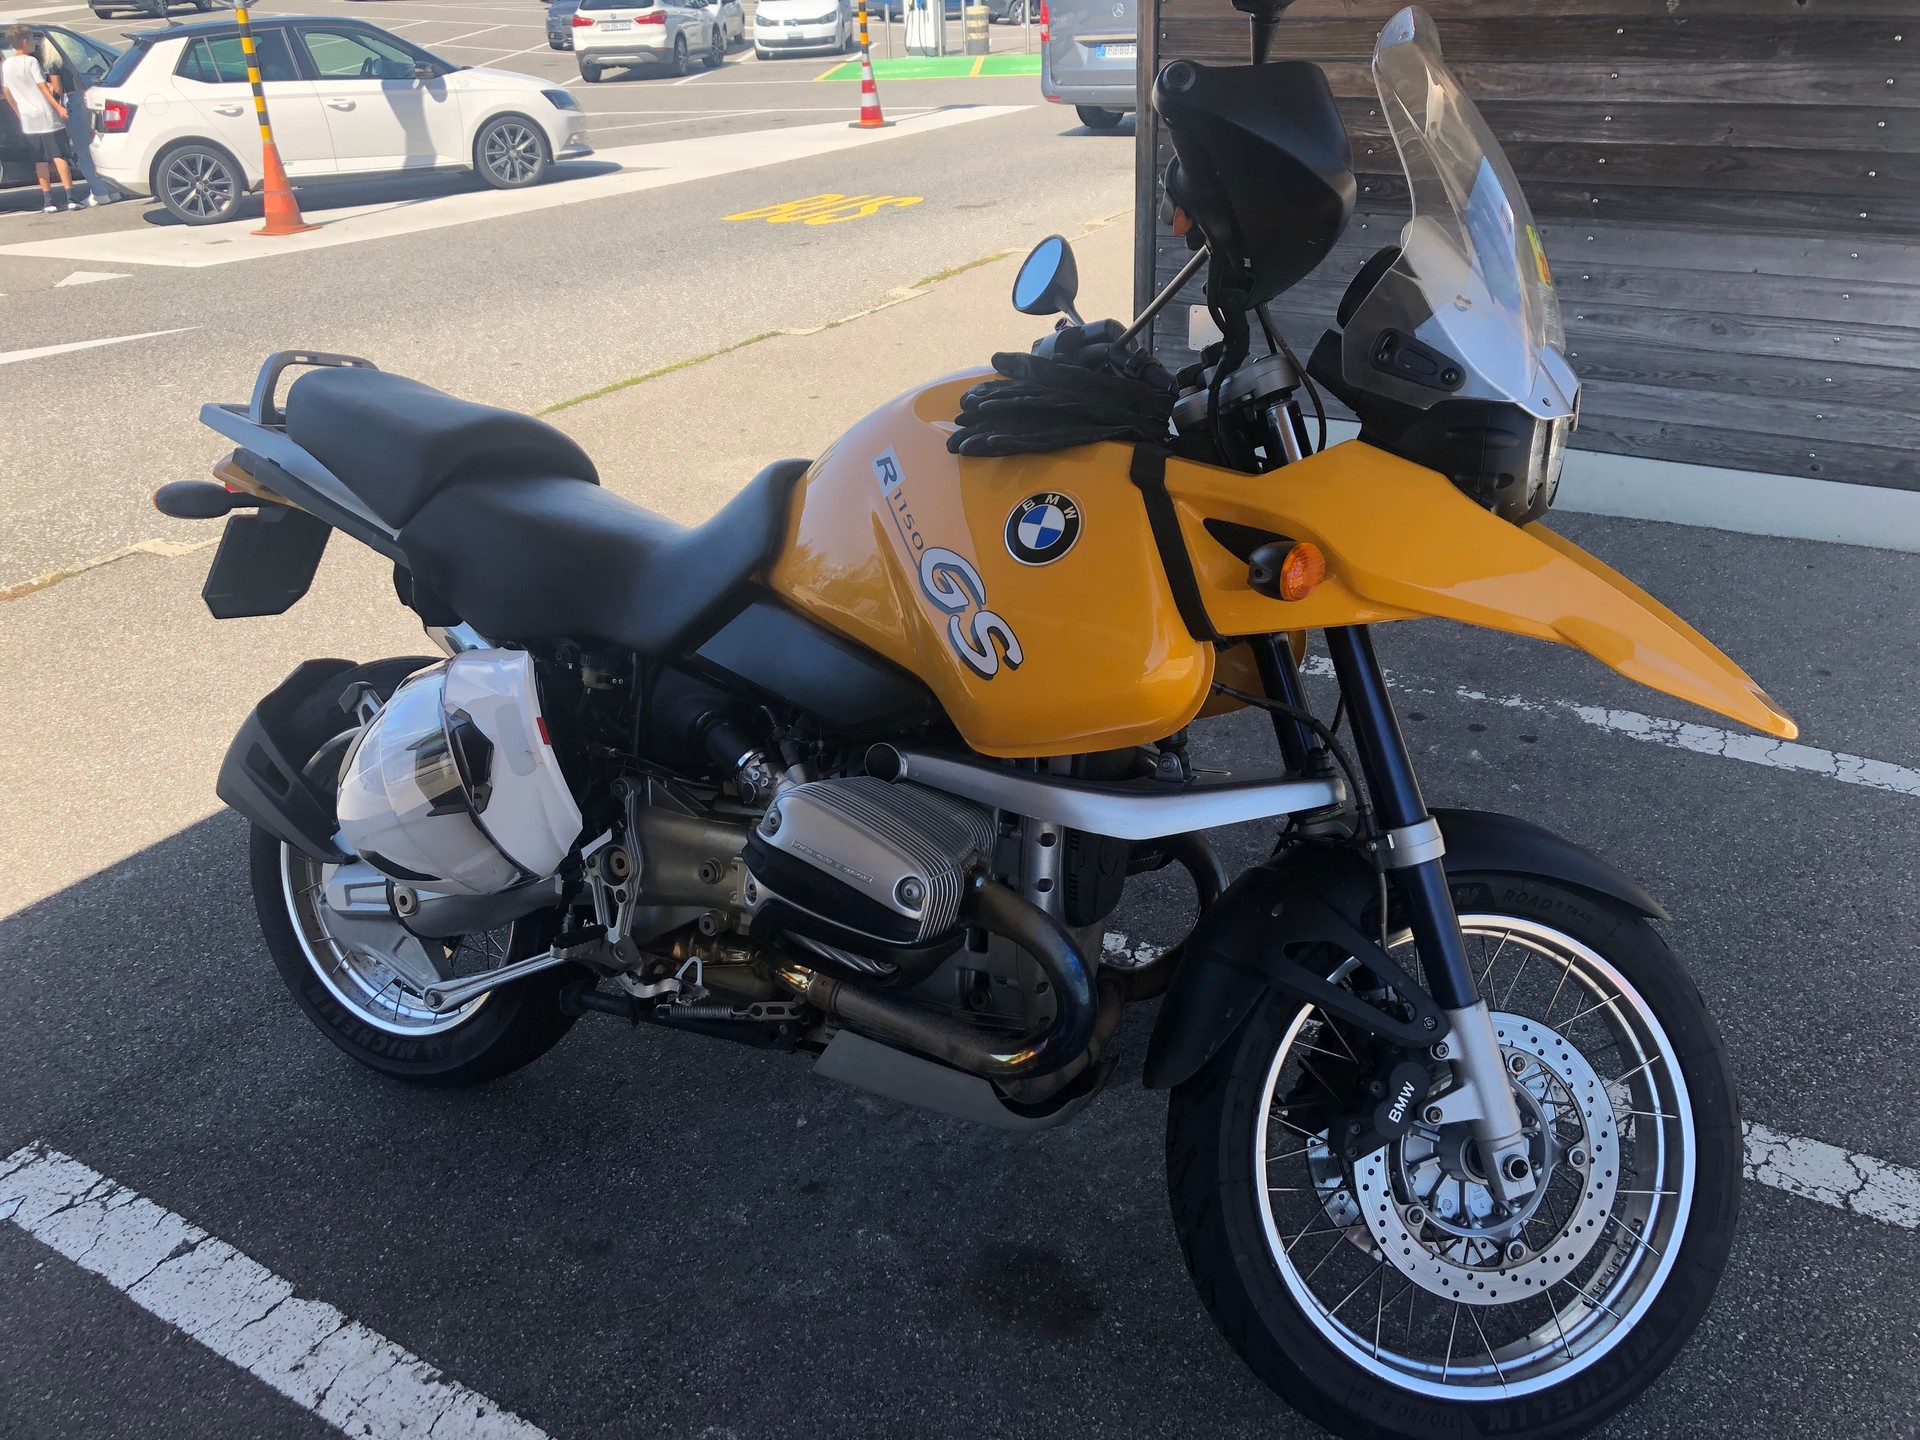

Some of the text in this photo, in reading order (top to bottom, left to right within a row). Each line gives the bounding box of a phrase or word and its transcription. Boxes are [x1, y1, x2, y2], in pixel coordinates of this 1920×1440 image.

[719, 193, 924, 225] BUS
[875, 456, 925, 551] R 1150
[1022, 494, 1078, 520] BMW
[918, 546, 1025, 681] GS
[1502, 888, 1553, 910] ROAD
[307, 987, 421, 1059] MICHELIN
[1388, 1080, 1415, 1123] BMW
[1488, 1323, 1660, 1431] MICHELIN
[1397, 1403, 1456, 1428] 110/80
